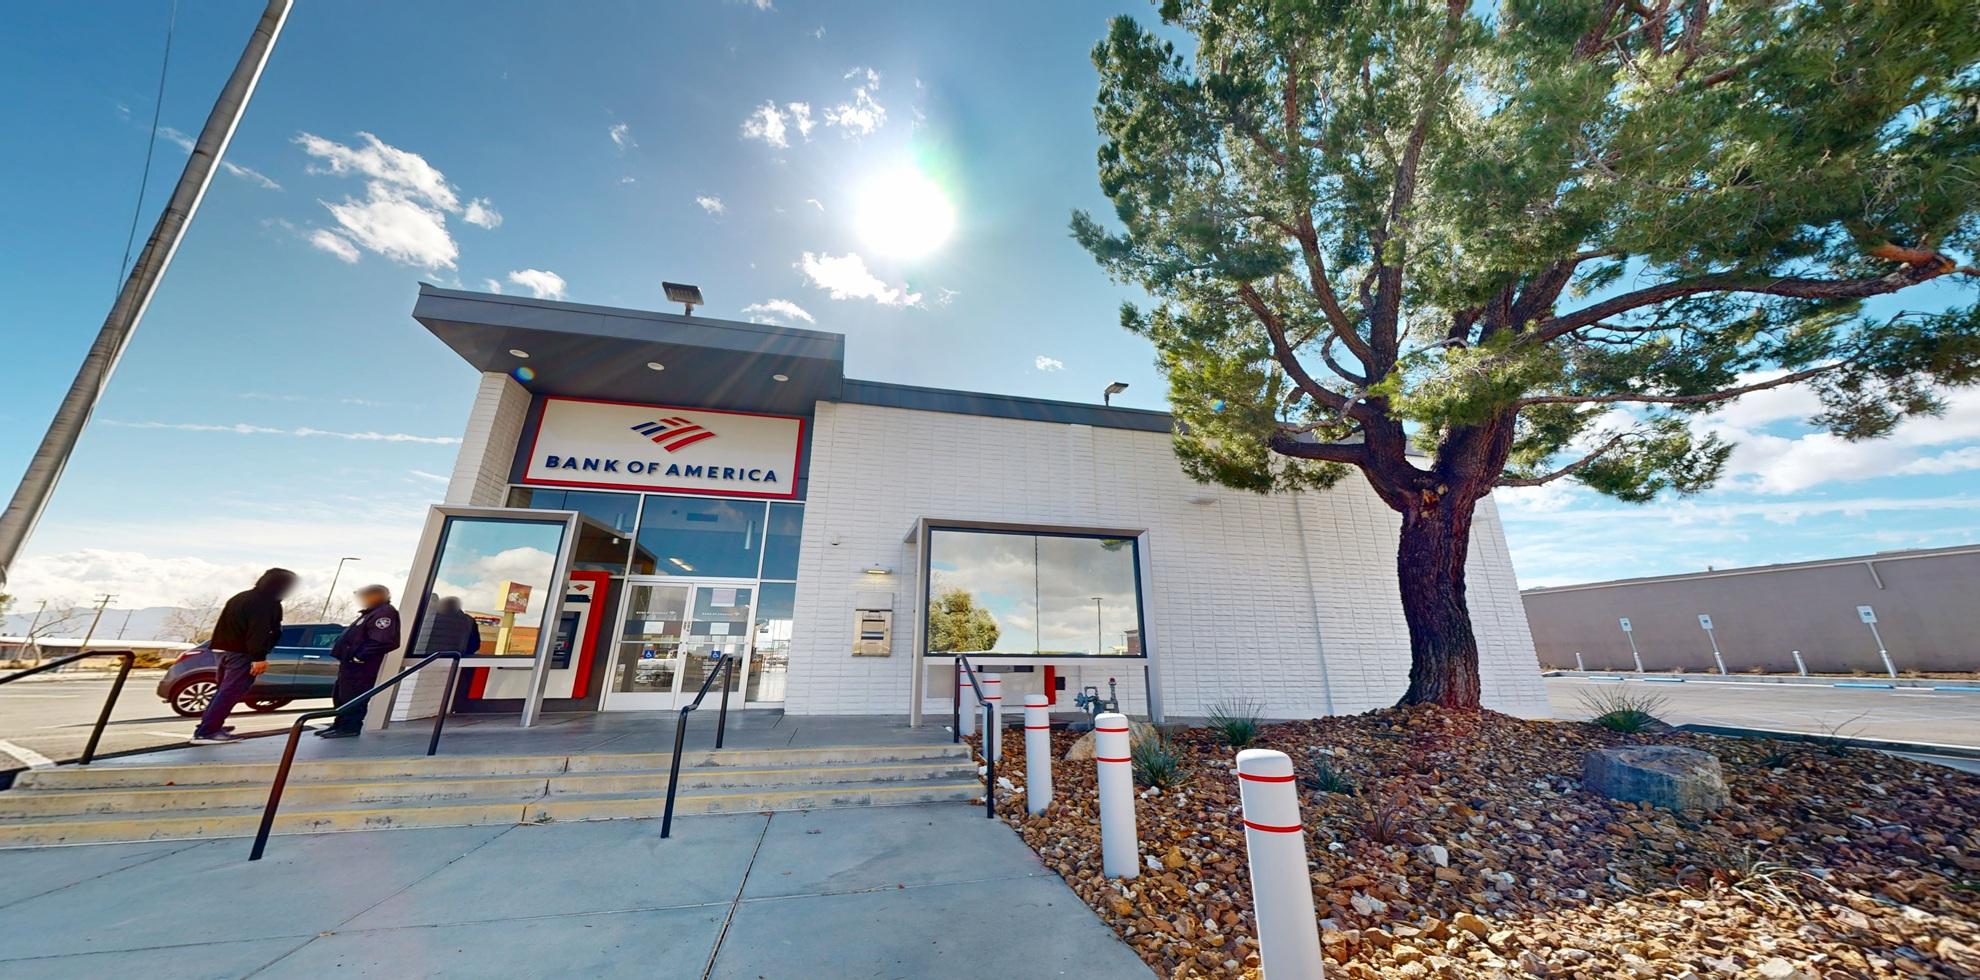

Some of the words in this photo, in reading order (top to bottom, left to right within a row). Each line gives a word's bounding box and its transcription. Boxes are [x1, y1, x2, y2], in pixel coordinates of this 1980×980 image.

[545, 455, 619, 473] BANK
[627, 461, 660, 475] OF
[665, 463, 778, 483] AMERICA
